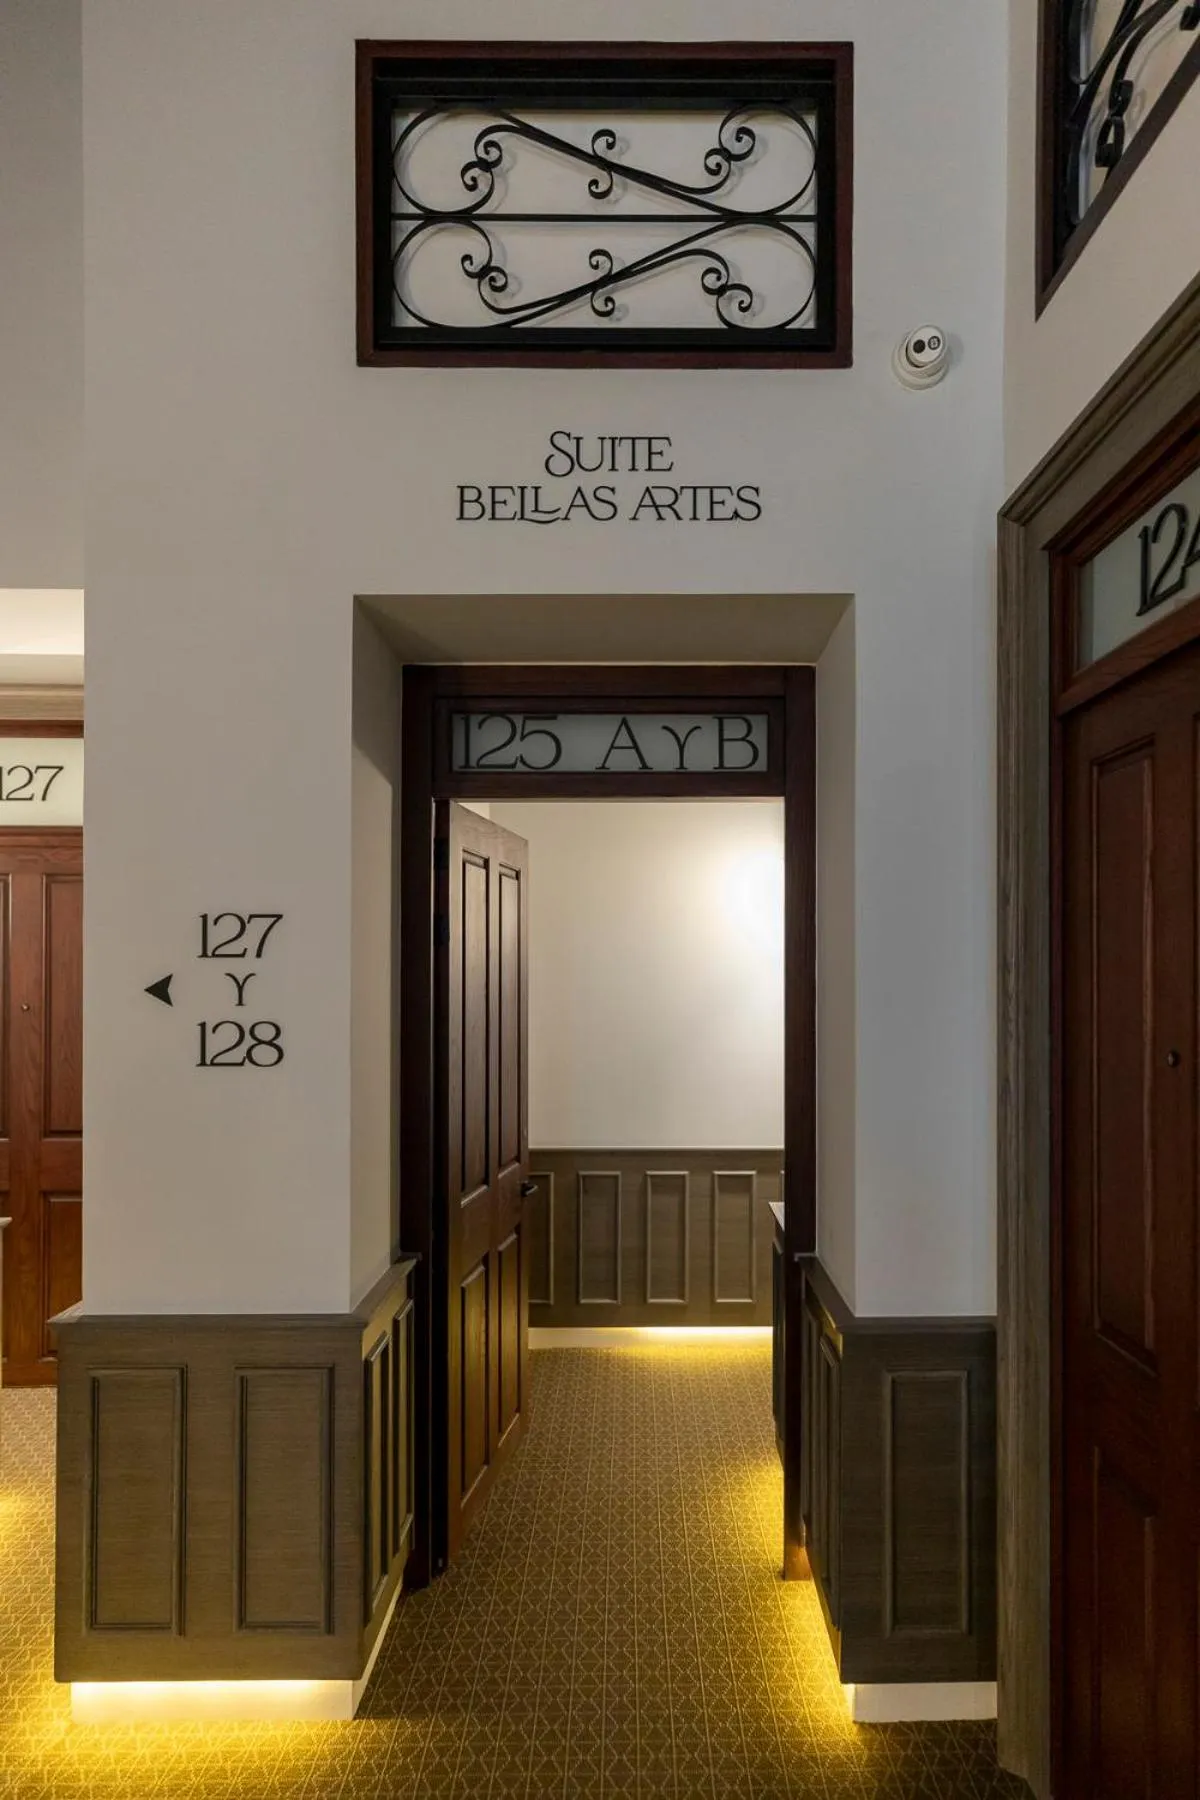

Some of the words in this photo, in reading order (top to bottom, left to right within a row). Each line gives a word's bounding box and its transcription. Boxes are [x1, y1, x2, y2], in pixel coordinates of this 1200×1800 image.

[544, 431, 674, 477] SUITE
[456, 485, 618, 524] BELLAS
[629, 485, 762, 521] ARTES
[458, 714, 562, 770] 125
[197, 913, 284, 958] 127
[224, 973, 256, 1006] Y
[196, 1020, 284, 1067] 128
